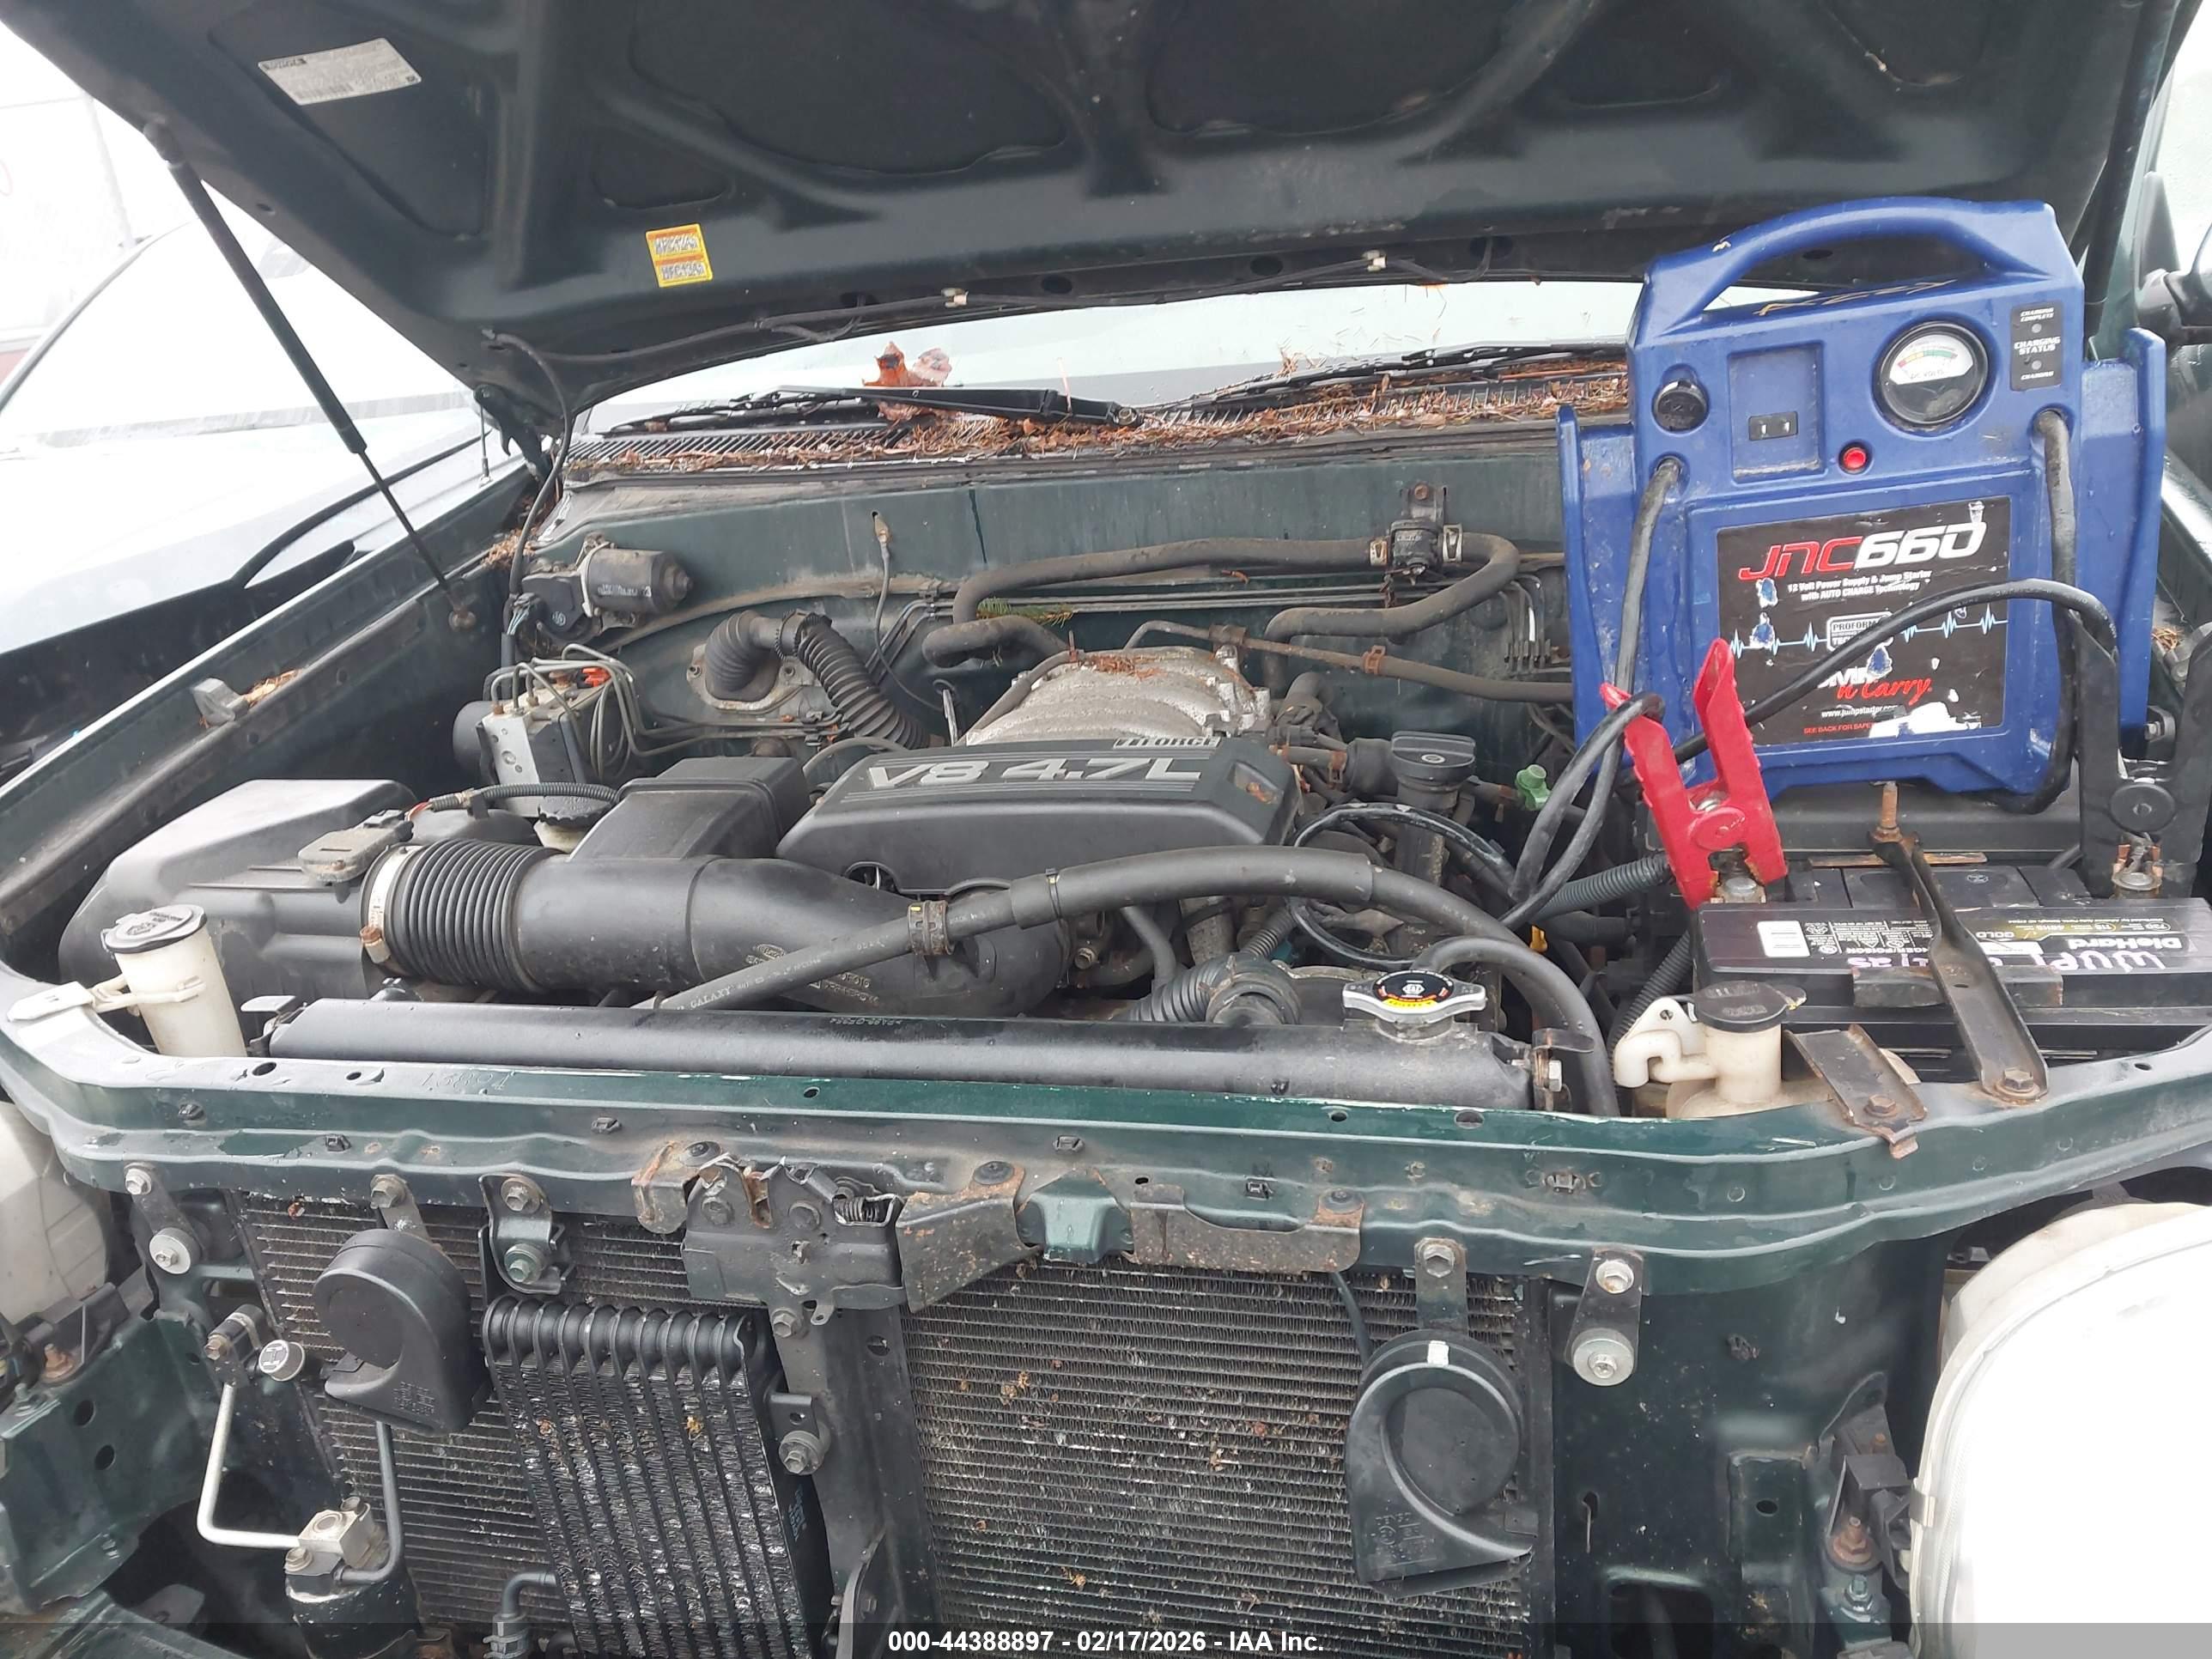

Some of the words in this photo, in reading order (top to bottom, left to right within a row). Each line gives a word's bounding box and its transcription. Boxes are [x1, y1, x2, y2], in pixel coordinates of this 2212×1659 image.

[2014, 336, 2061, 349] CHARGING
[2019, 343, 2056, 356] STATUS
[1738, 522, 1987, 581] JNC660
[1788, 582, 1799, 593] 12
[1799, 580, 1815, 592] Volt
[1816, 578, 1842, 590] Power
[1843, 575, 1870, 590] Supply
[1879, 574, 1903, 586] Jump
[1903, 569, 1932, 581] Starter
[1801, 590, 1820, 601] with
[1820, 588, 1841, 600] AUTO
[1842, 586, 1875, 599] CHARGE
[1832, 619, 1878, 631] PROFORM
[1804, 726, 1818, 735] SEE
[1819, 725, 1837, 733] BACK
[1838, 723, 1853, 732] FOR
[869, 760, 989, 790] V8
[1001, 757, 1201, 782] 4.7L
[2069, 937, 2182, 950] DieHard
[690, 987, 731, 1009] GALAXY
